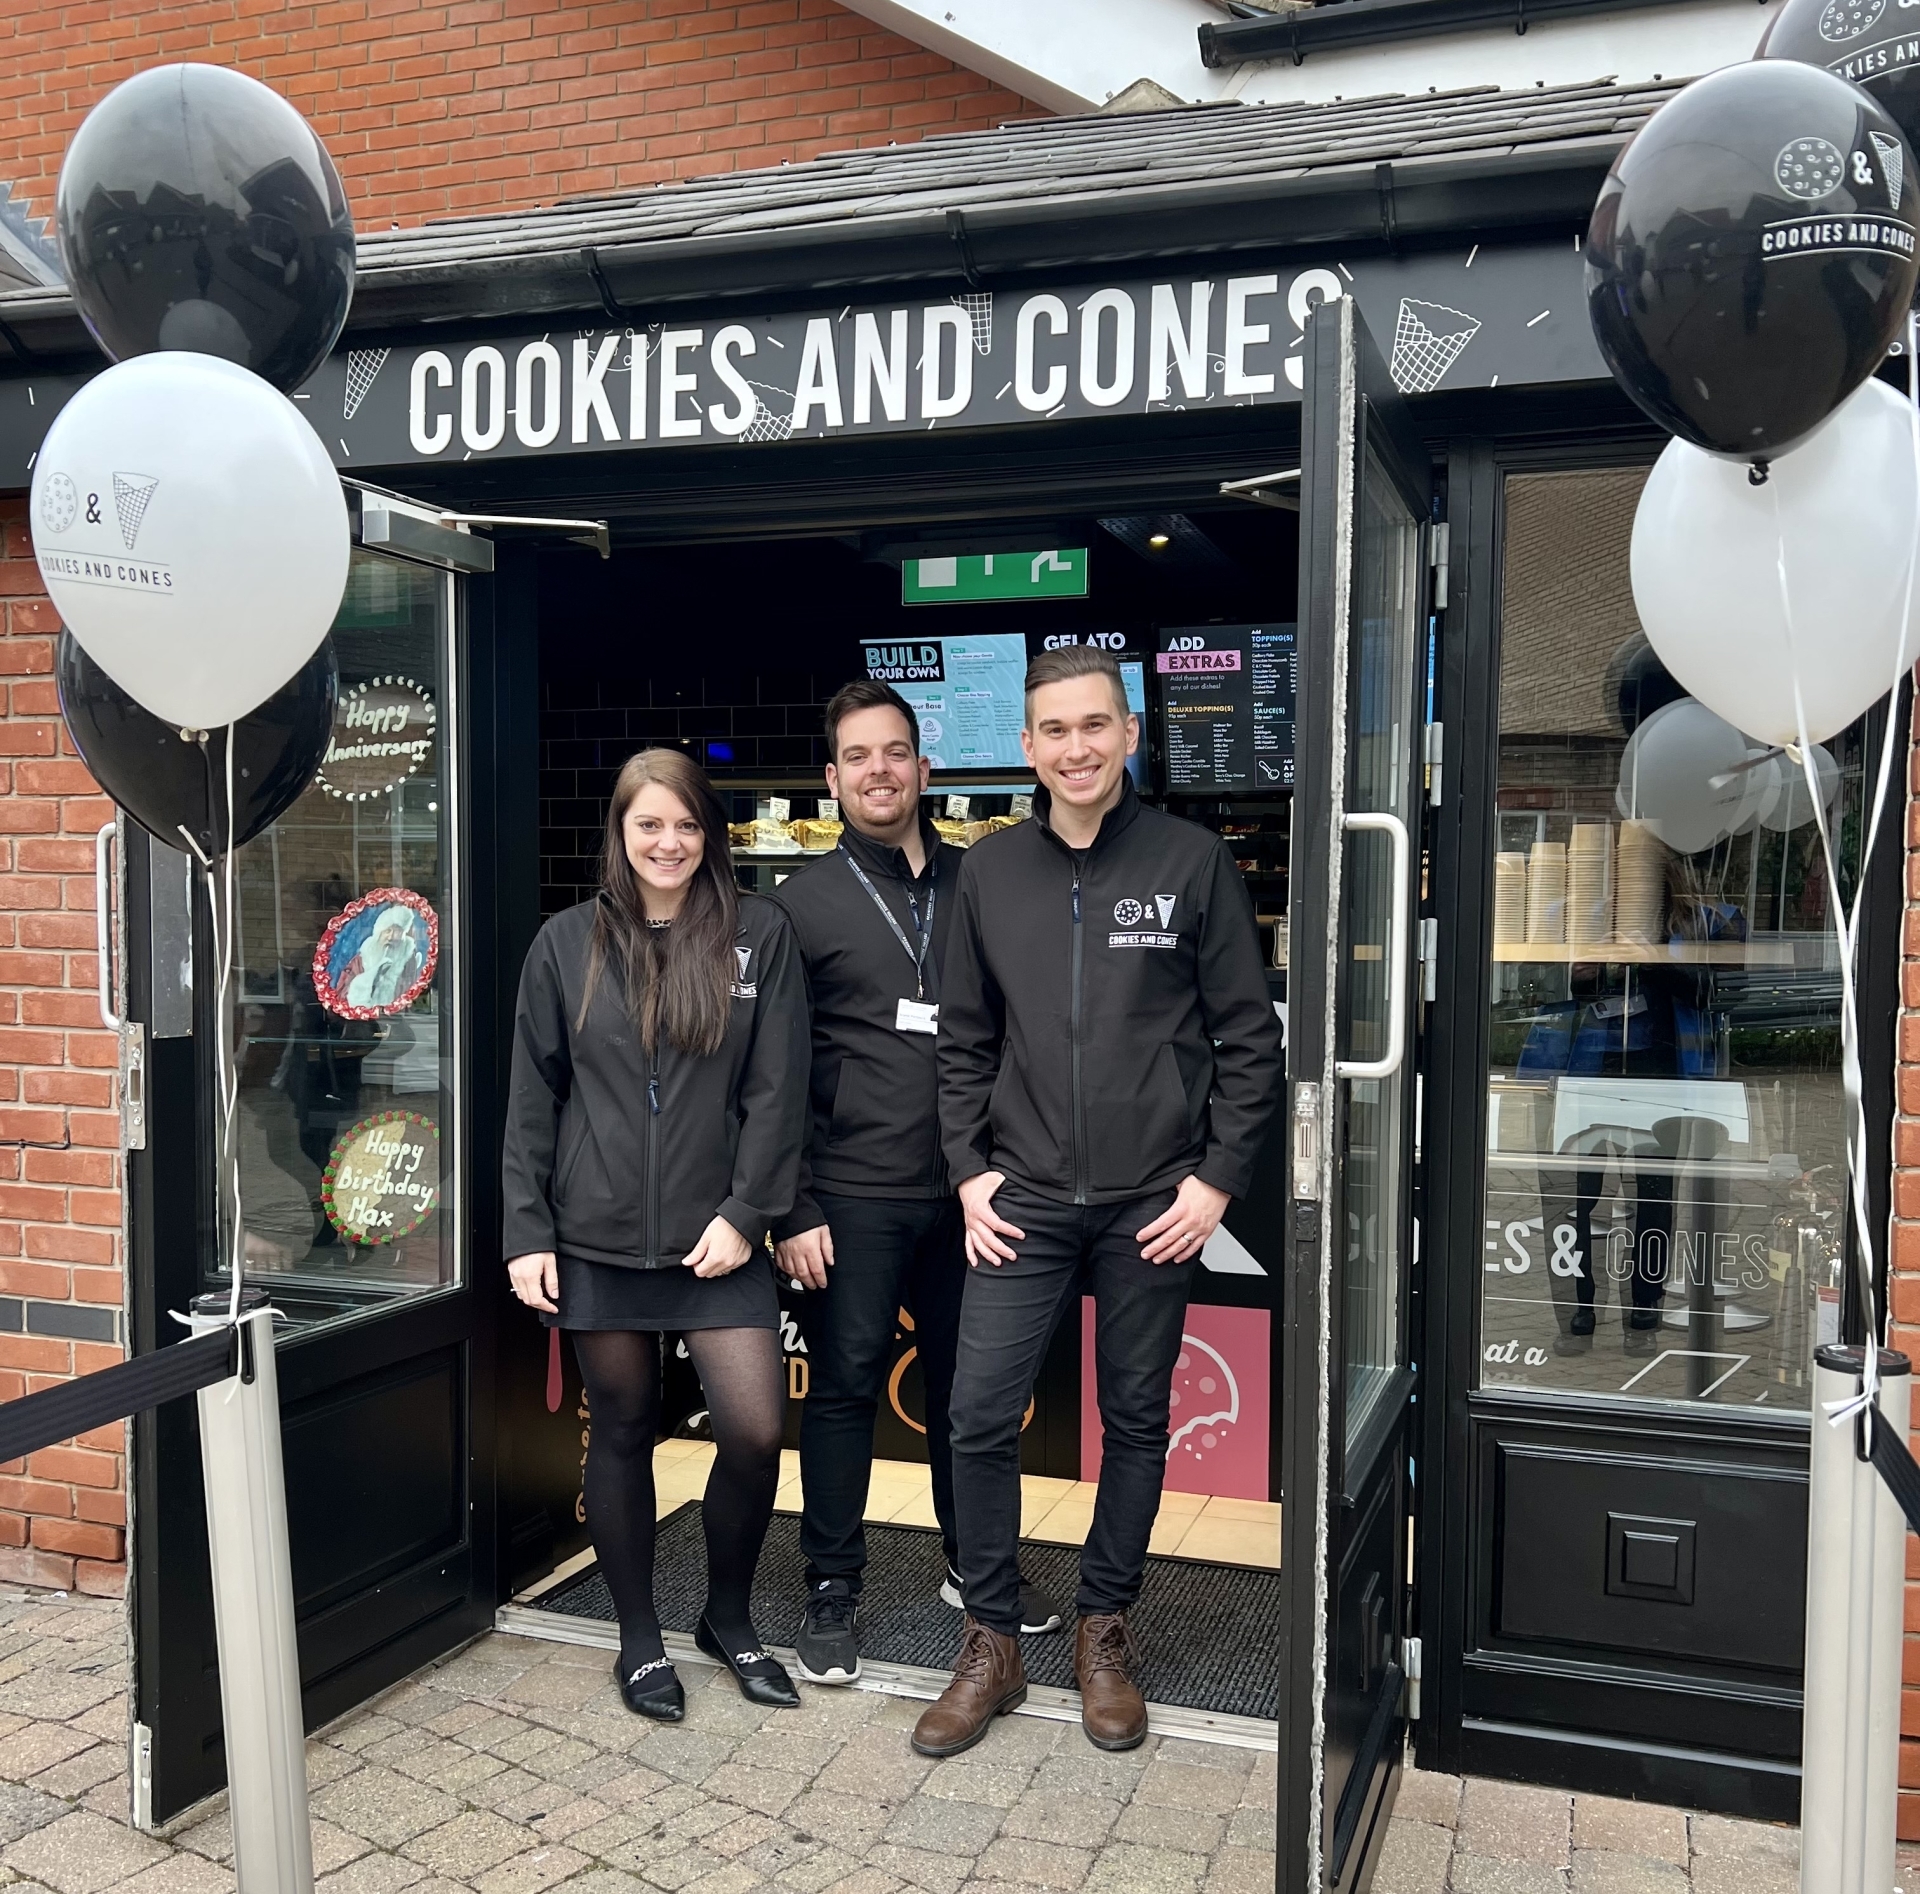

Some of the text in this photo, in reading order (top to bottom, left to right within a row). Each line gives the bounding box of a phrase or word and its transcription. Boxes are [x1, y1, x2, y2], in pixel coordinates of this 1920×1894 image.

[1836, 50, 1887, 79] KIES
[1852, 150, 1873, 184] &
[1762, 223, 1915, 253] COOKIES AND CONES
[409, 268, 1342, 455] COOKIES AND CONES
[86, 493, 102, 525] &
[41, 556, 172, 587] COOKIES AND CONES
[1167, 636, 1205, 652] ADD
[1252, 635, 1293, 643] TOPPING(S)
[865, 645, 938, 668] BUILD
[1168, 654, 1236, 670] EXTRAS
[866, 666, 940, 680] YOUR OWN
[346, 699, 411, 735] Happy
[1253, 707, 1285, 715] SAUCE(S)
[321, 736, 433, 764] Anniversary
[1144, 904, 1155, 919] &
[1108, 934, 1178, 946] COOKIES AND CONES
[365, 1130, 425, 1172] Happy
[337, 1165, 434, 1213] Birthday
[347, 1196, 394, 1228] Max
[1550, 1223, 1586, 1278] &
[1605, 1226, 1770, 1290] CONES
[1523, 1346, 1549, 1366] a
